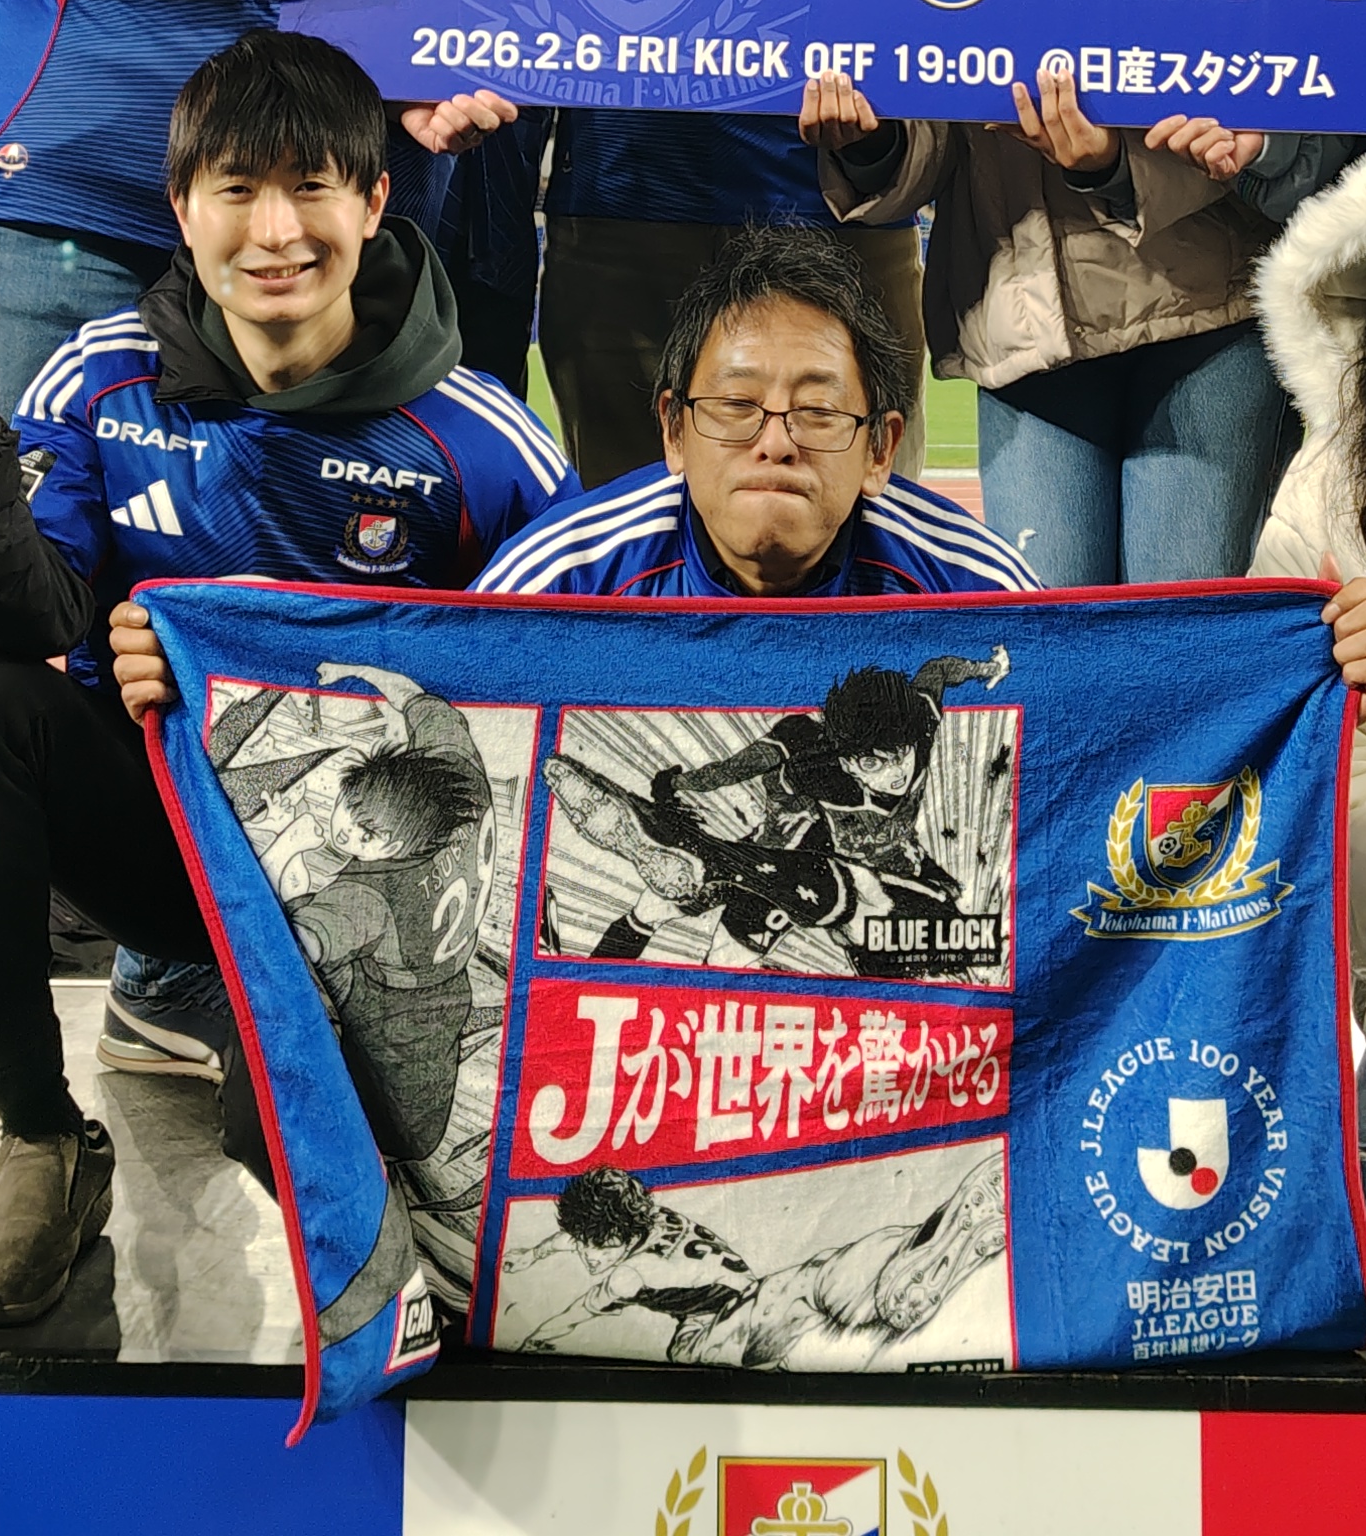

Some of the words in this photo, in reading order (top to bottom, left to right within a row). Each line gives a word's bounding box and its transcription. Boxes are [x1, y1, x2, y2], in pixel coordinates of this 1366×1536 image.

[411, 27, 602, 73] 2026.2.6
[616, 35, 679, 75] FRI
[693, 38, 790, 81] KICK
[803, 41, 877, 82] OFF
[894, 44, 1015, 87] 19:00
[96, 417, 209, 462] DRAFT
[320, 457, 443, 496] DRAFT
[868, 919, 929, 952] BLUE
[935, 918, 996, 950] LOCK
[1098, 910, 1178, 933] Yokohama
[528, 995, 1000, 1165] Jが世界を驚かせる
[1188, 1039, 1240, 1077] 100
[1081, 1037, 1175, 1157] J.LEAGUE
[1242, 1066, 1287, 1152] YEAR
[1085, 1170, 1191, 1265] LEAGUE
[1204, 1166, 1287, 1258] VISION
[1127, 1269, 1258, 1315] 明治安田
[1131, 1304, 1259, 1341] J.LEAGUE
